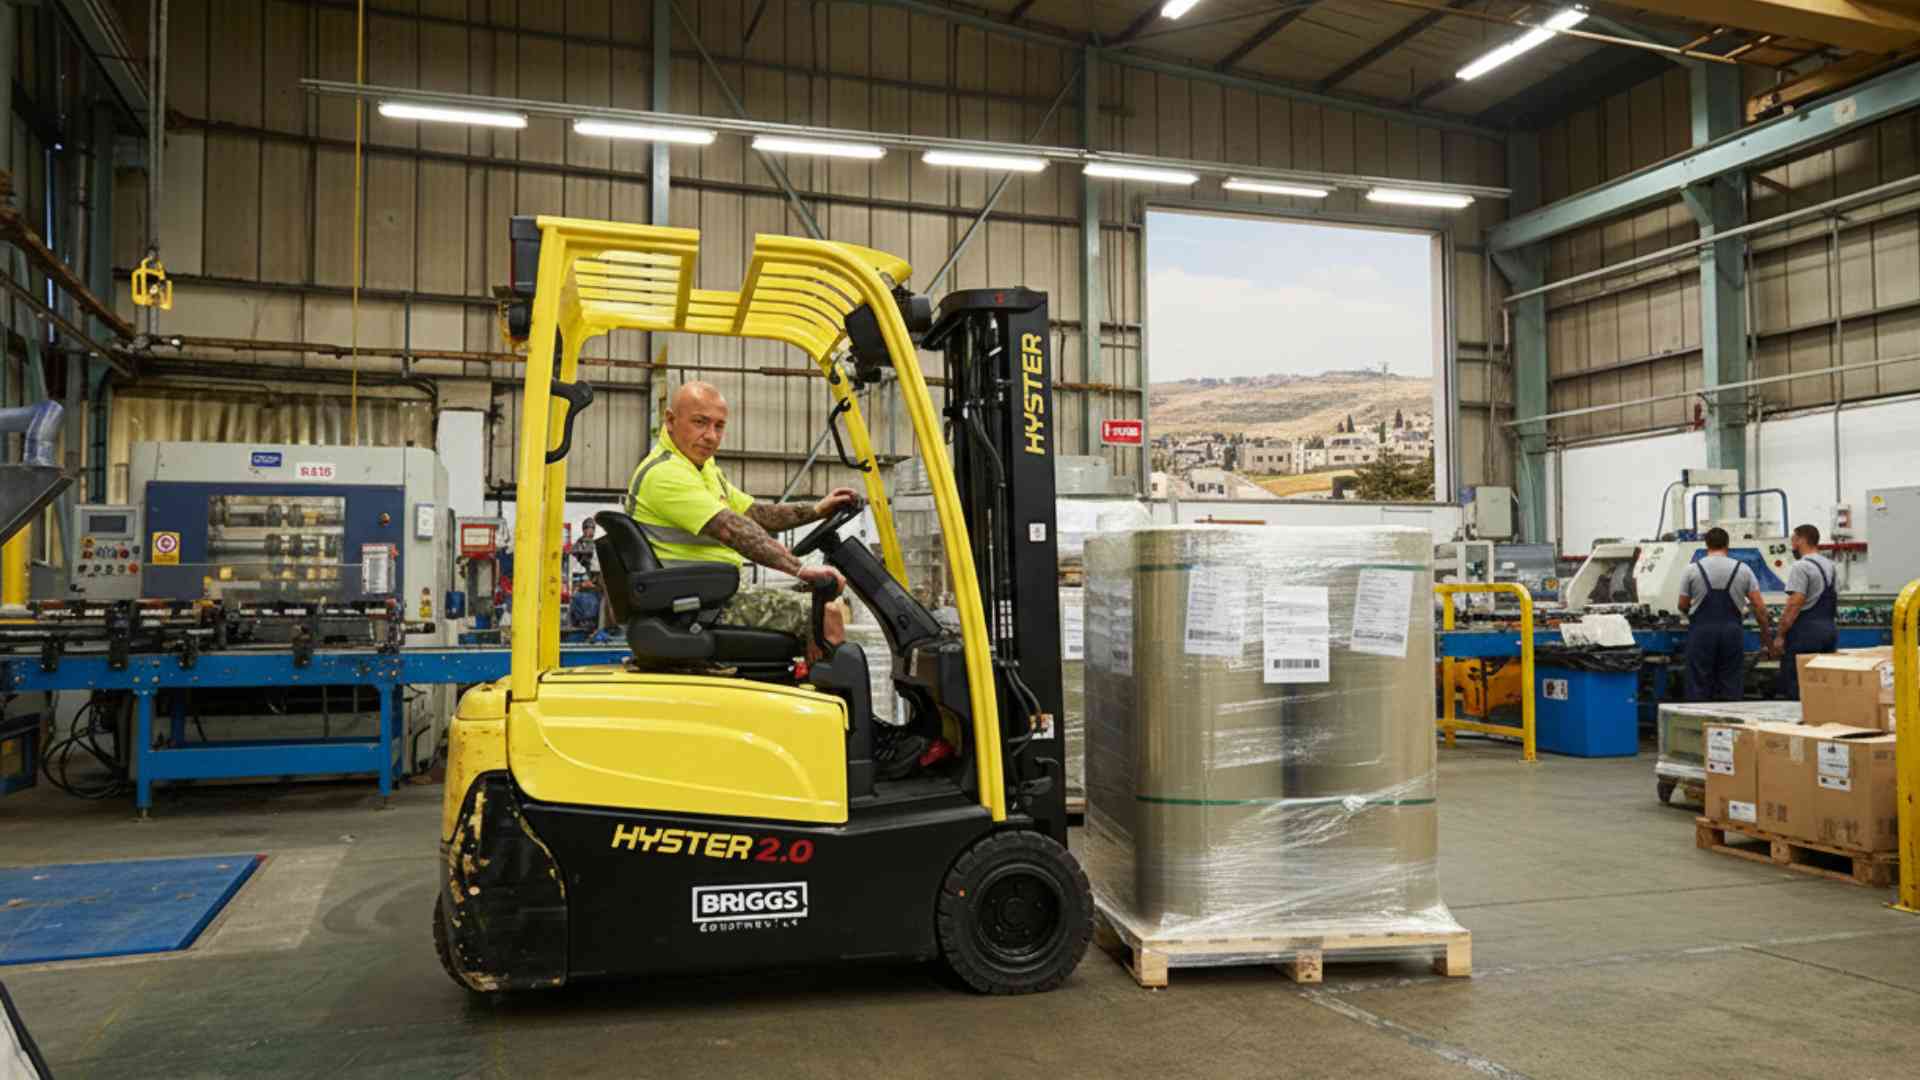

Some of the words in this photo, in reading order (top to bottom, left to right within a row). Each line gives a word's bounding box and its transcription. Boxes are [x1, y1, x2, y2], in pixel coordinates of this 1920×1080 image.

[1021, 333, 1046, 455] HYSTER
[612, 824, 753, 860] HYSTER
[756, 837, 814, 863] 2.0
[701, 889, 798, 914] BRIGGS
